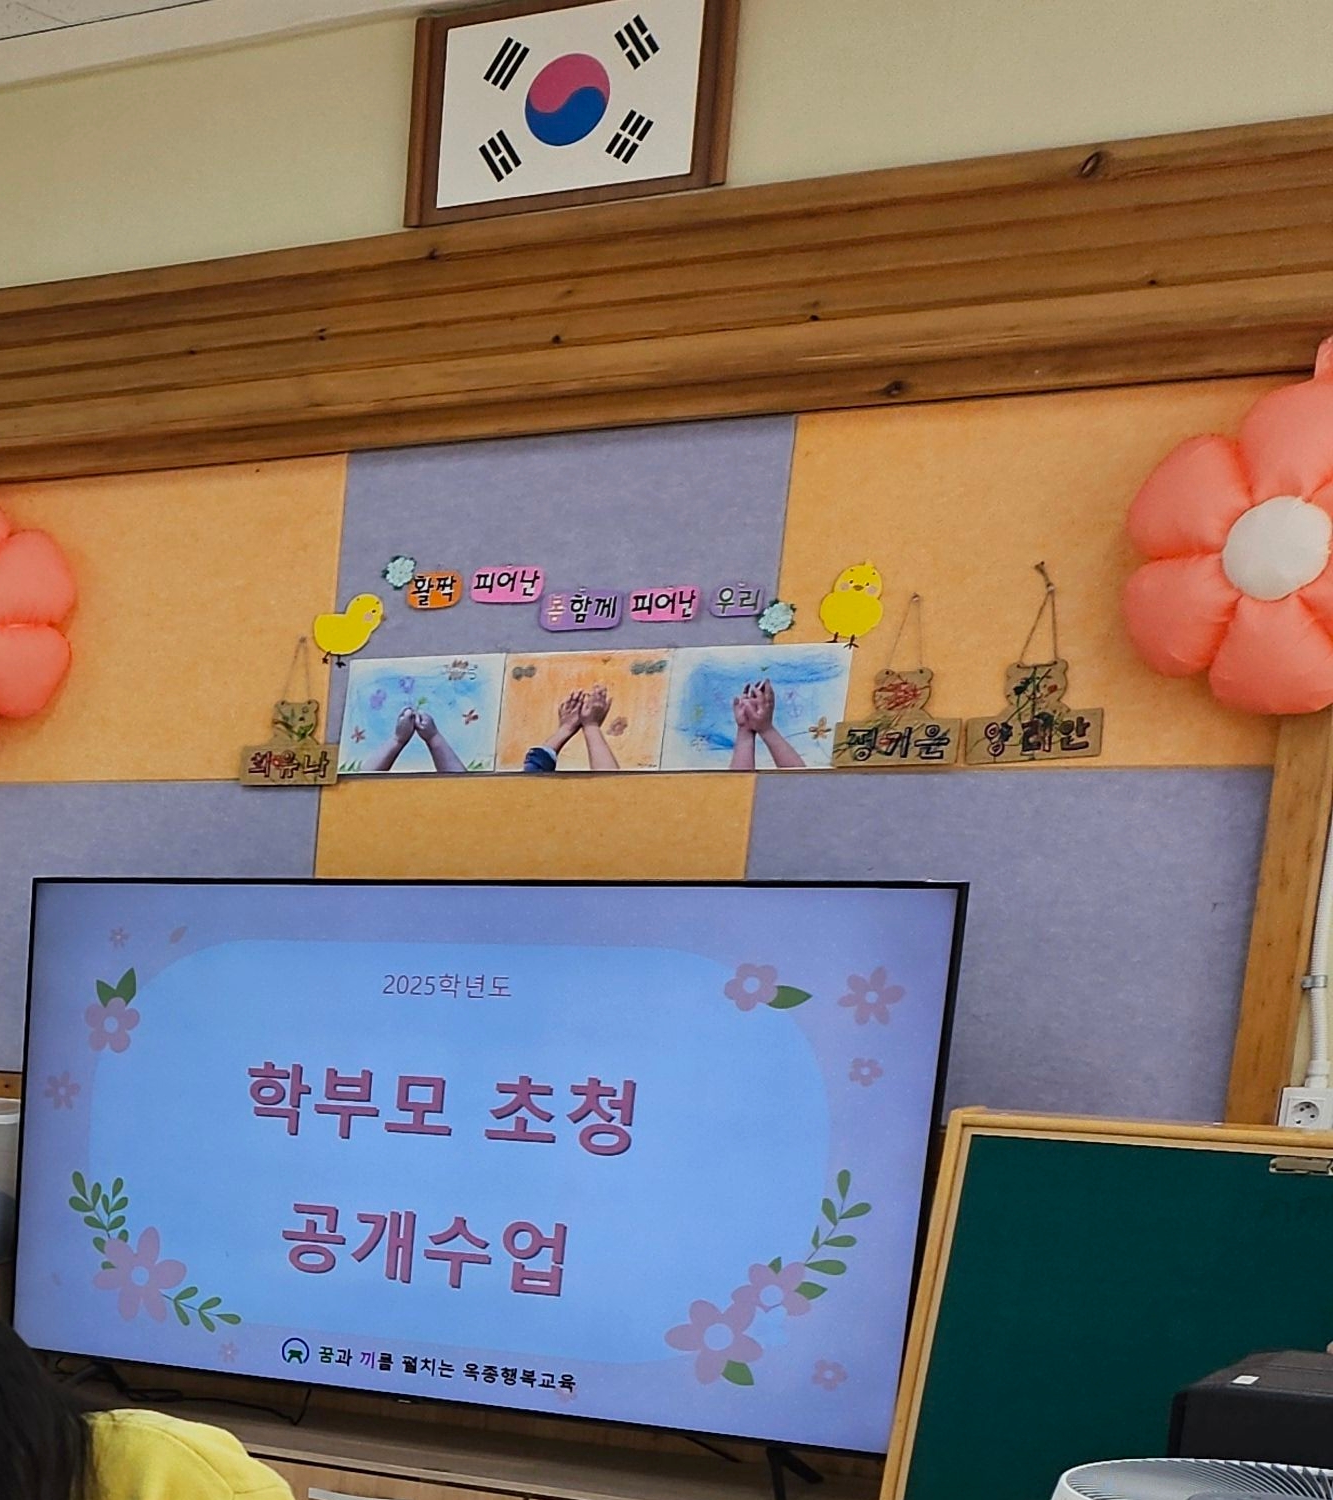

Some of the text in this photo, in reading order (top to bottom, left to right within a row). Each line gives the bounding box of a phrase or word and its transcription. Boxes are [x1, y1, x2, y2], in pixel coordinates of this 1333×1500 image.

[410, 574, 457, 607] 활짝
[473, 569, 541, 597] 피어난
[569, 593, 618, 624] 함께
[631, 588, 697, 618] 피어난
[714, 587, 761, 614] 우리
[382, 973, 512, 999] 2025학년도
[247, 1061, 637, 1157] 학부모 초청
[281, 1202, 569, 1297] 공개수업
[318, 1345, 577, 1394] 꿈과 끼를 펼치는 옥종행복교육
